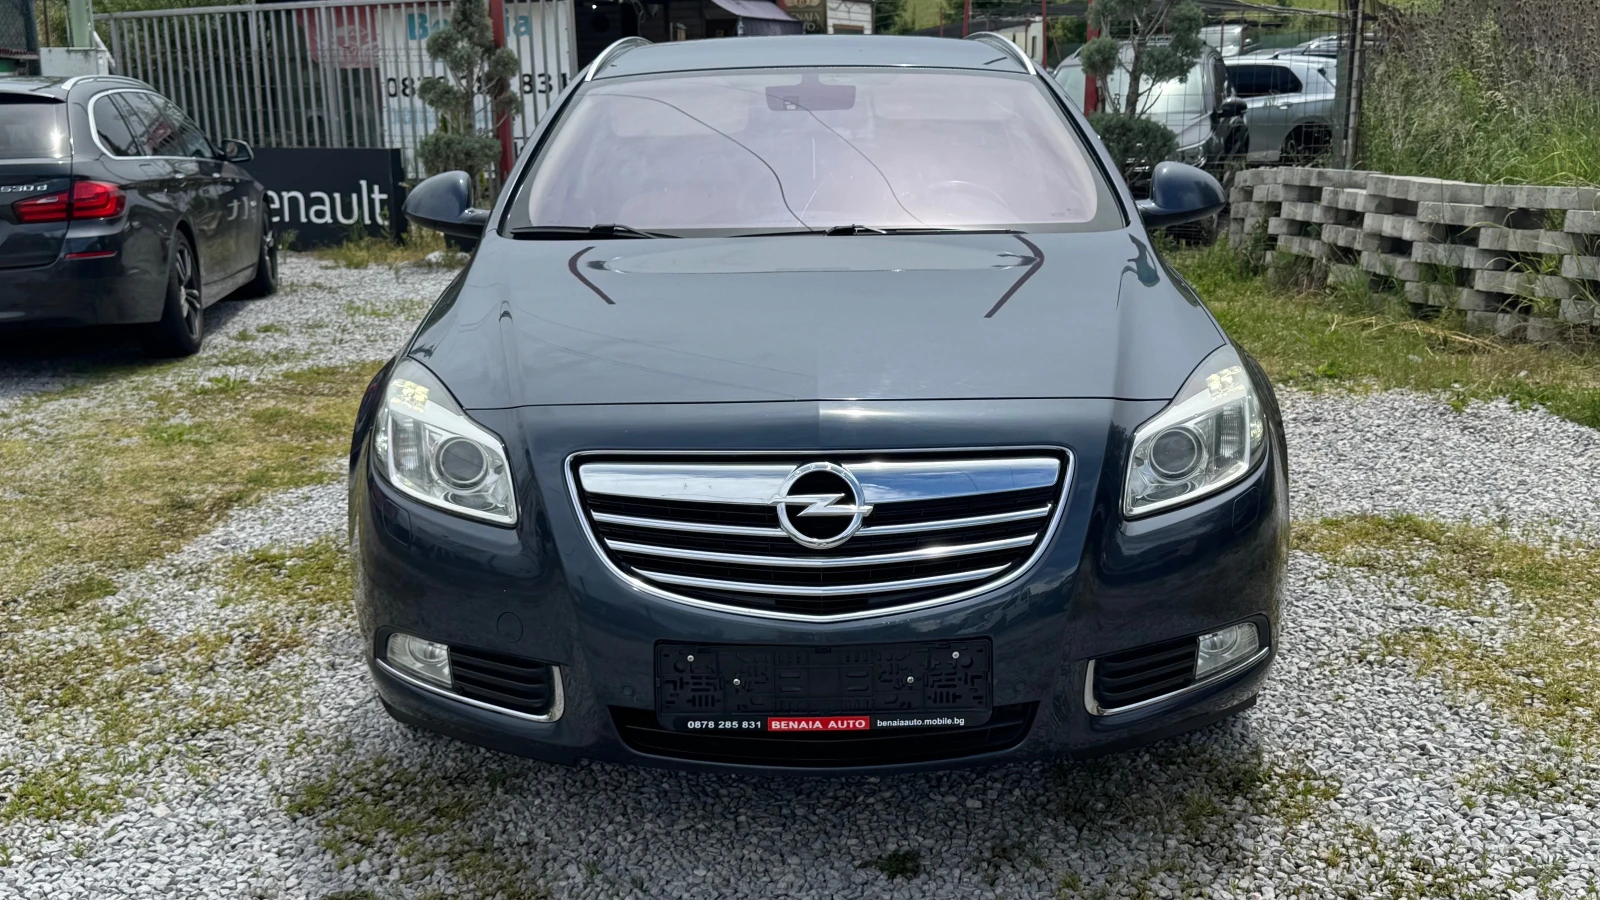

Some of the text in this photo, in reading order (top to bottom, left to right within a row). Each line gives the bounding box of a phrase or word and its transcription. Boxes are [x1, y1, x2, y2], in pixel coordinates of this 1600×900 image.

[266, 179, 389, 225] enault
[687, 720, 762, 729] 0878 285 831
[771, 719, 866, 729] BENAIA AUTO
[877, 716, 965, 728] benaiaauto.mobile.bg
